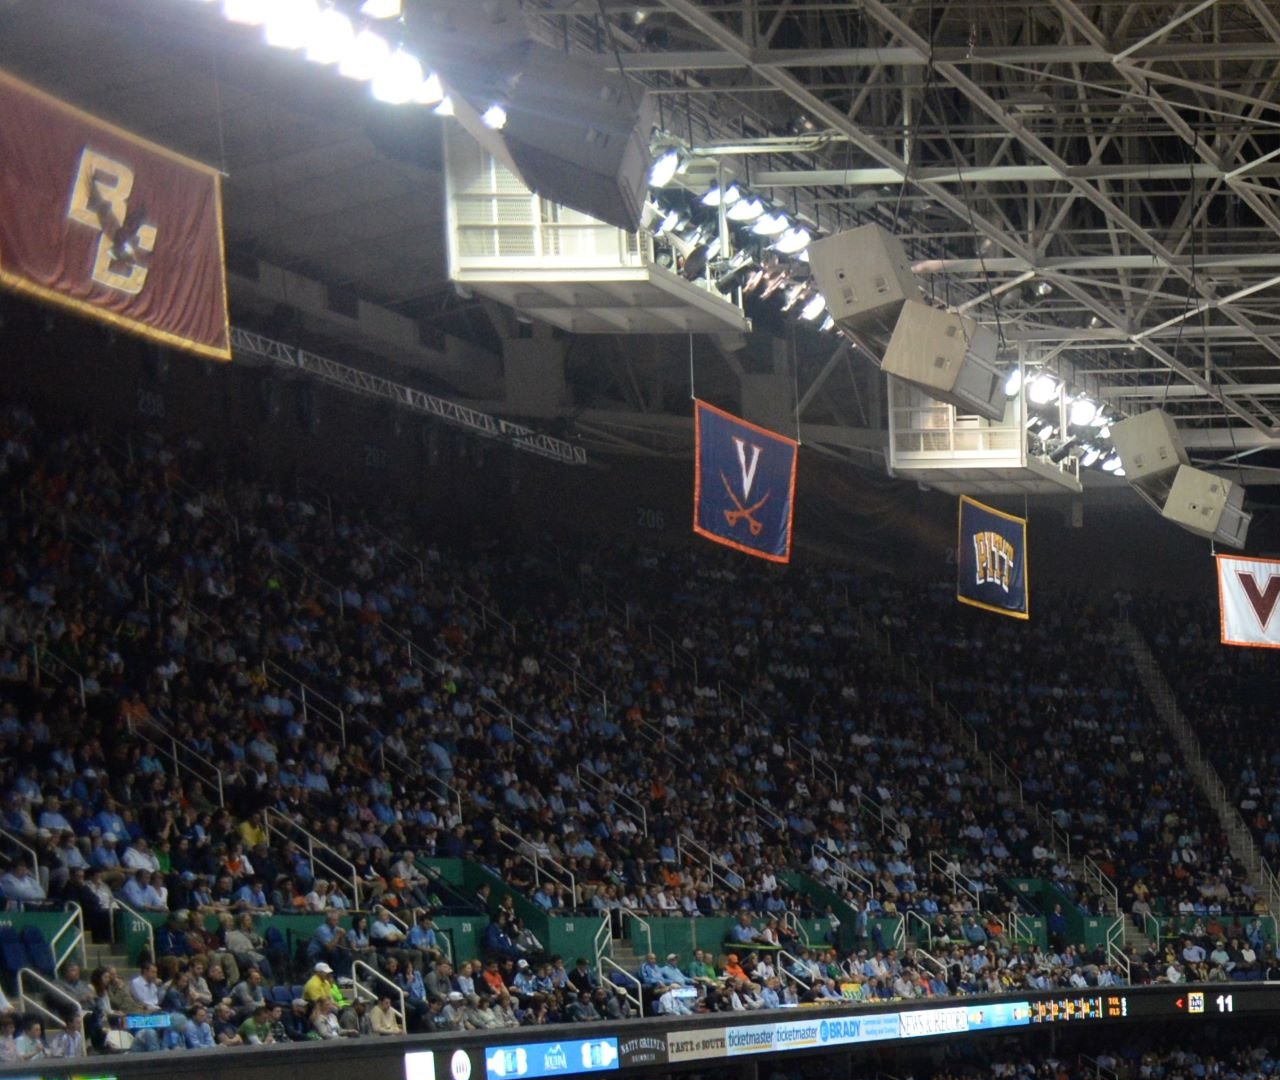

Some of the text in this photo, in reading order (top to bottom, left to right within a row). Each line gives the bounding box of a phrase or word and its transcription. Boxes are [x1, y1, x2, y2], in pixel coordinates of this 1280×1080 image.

[1216, 995, 1233, 1012] 11
[728, 1029, 774, 1047] ticketmaster
[776, 1025, 818, 1043] ticketmaster
[829, 1020, 861, 1039] BRADY
